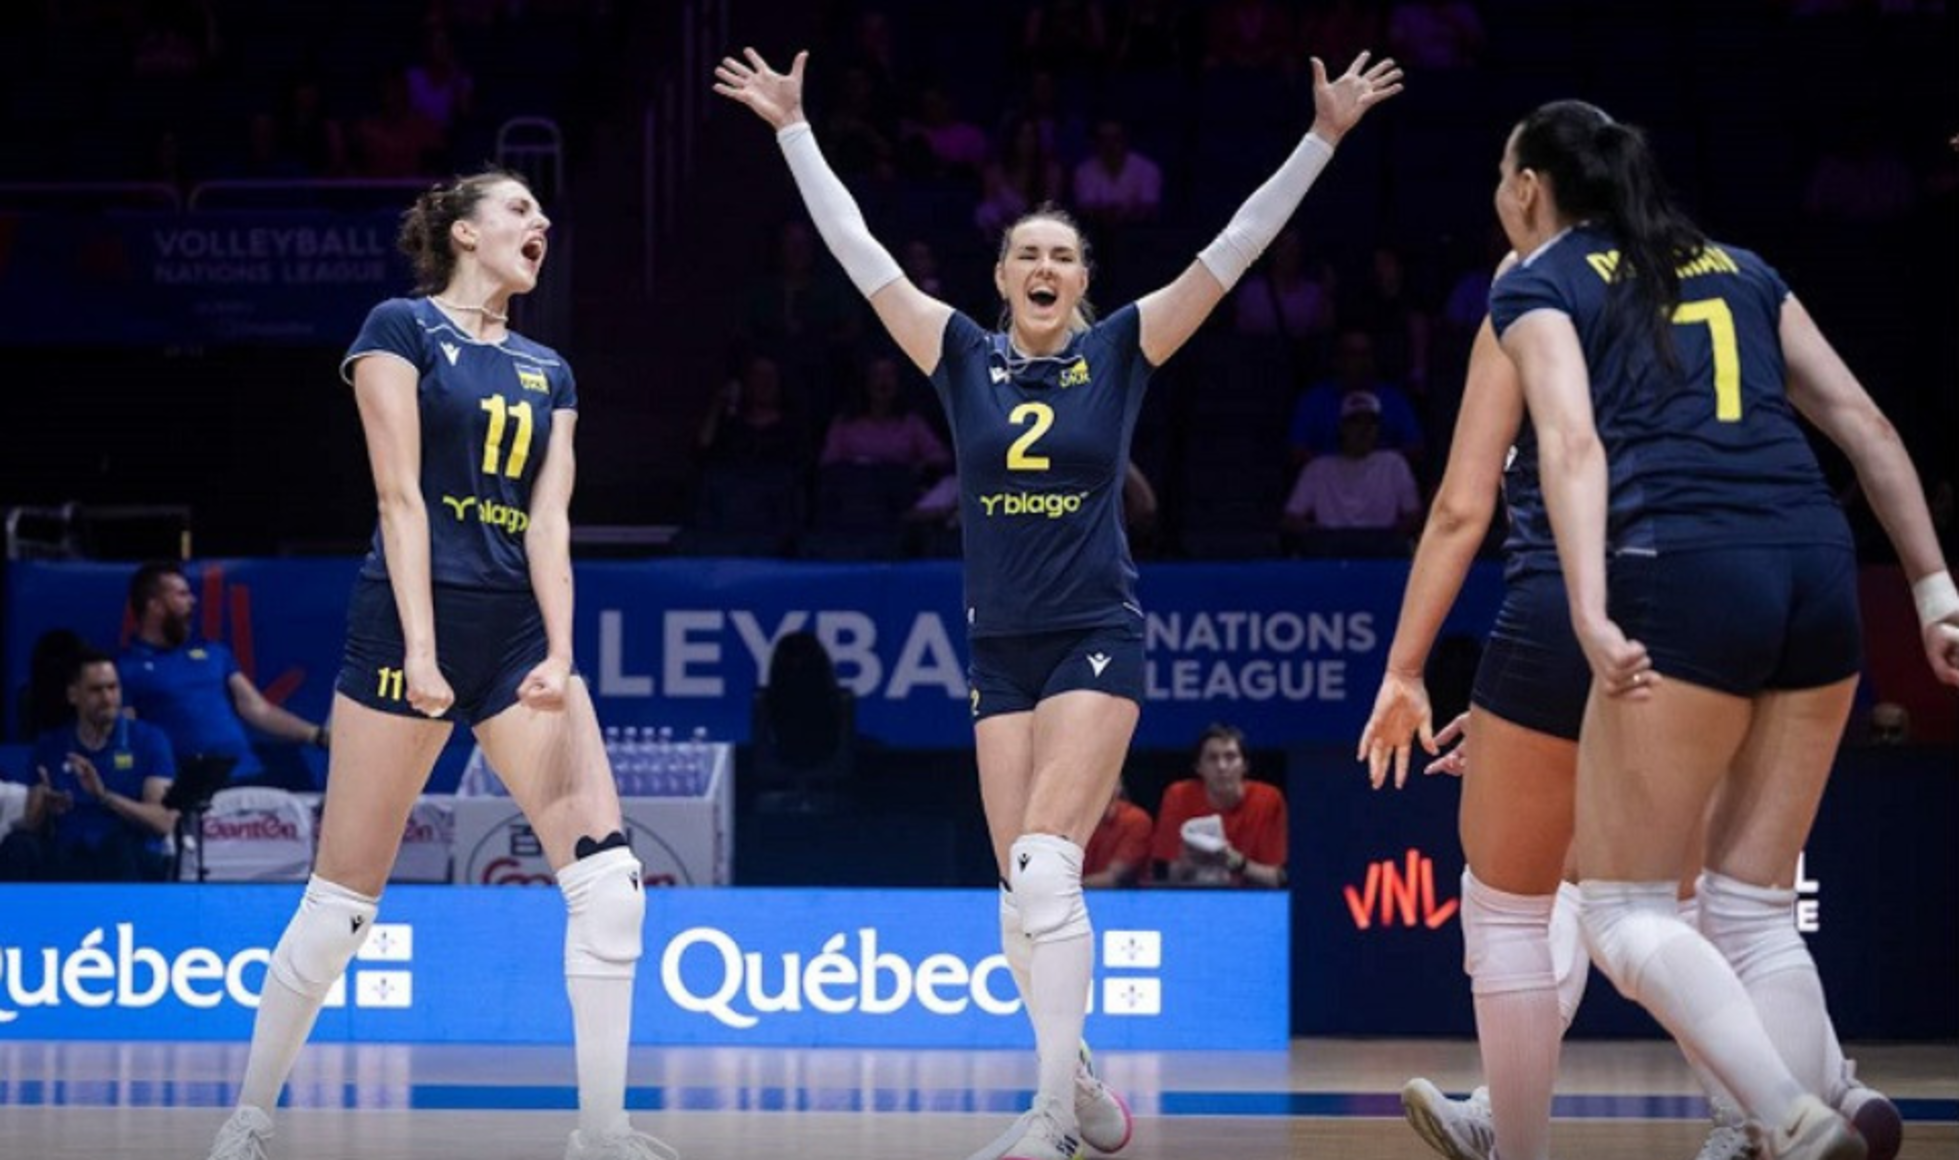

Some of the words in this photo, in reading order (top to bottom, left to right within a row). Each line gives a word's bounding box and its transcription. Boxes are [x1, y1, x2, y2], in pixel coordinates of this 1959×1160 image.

[153, 228, 386, 259] VOLLEYBALL
[154, 261, 272, 284] NATIONS
[282, 261, 386, 284] LEAGUE
[1661, 297, 1742, 423] 7
[481, 394, 532, 479] 11
[1006, 402, 1054, 470] 2
[378, 667, 403, 700] 11
[600, 611, 967, 697] LEYBA
[1145, 611, 1376, 652] NATIONS
[1145, 660, 1346, 700] LEAGUE
[1343, 848, 1460, 929] VNL
[0, 923, 272, 1022] uébec
[661, 927, 1021, 1028] Québec
